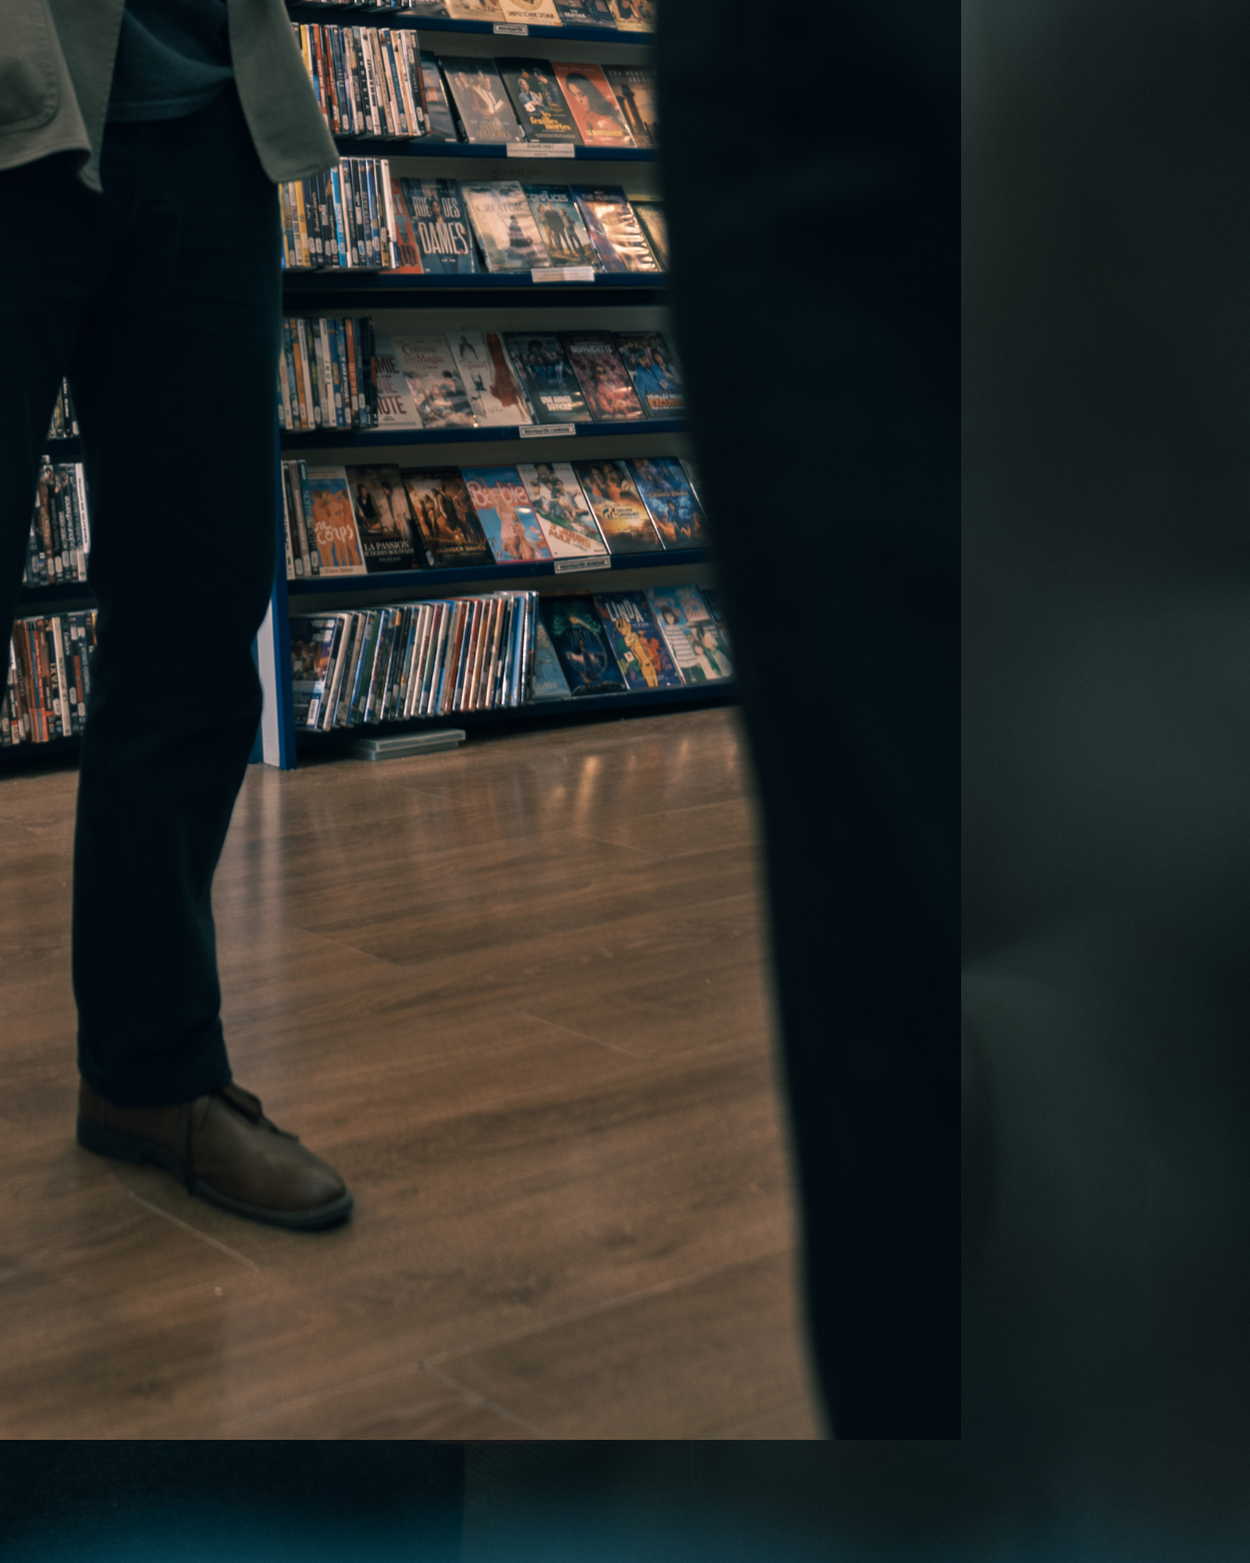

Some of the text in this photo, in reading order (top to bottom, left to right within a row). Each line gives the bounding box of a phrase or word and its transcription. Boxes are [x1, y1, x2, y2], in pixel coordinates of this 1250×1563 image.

[530, 116, 559, 127] feuilles
[544, 123, 572, 133] mortes
[526, 193, 569, 203] COMPLICES
[411, 196, 461, 219] RUE DES
[476, 202, 524, 214] CREATOR
[418, 222, 469, 255] DAMES
[401, 343, 438, 354] Comme
[569, 344, 614, 354] BERNADETTE
[553, 395, 573, 404] ANNÉE
[646, 393, 669, 401] VEUILLEZ
[466, 479, 528, 509] Barbie
[612, 511, 640, 519] TURISMO
[316, 524, 354, 545] corps
[376, 540, 411, 551] PASSION
[436, 546, 463, 555] HUNGER
[604, 598, 645, 623] LINDA
